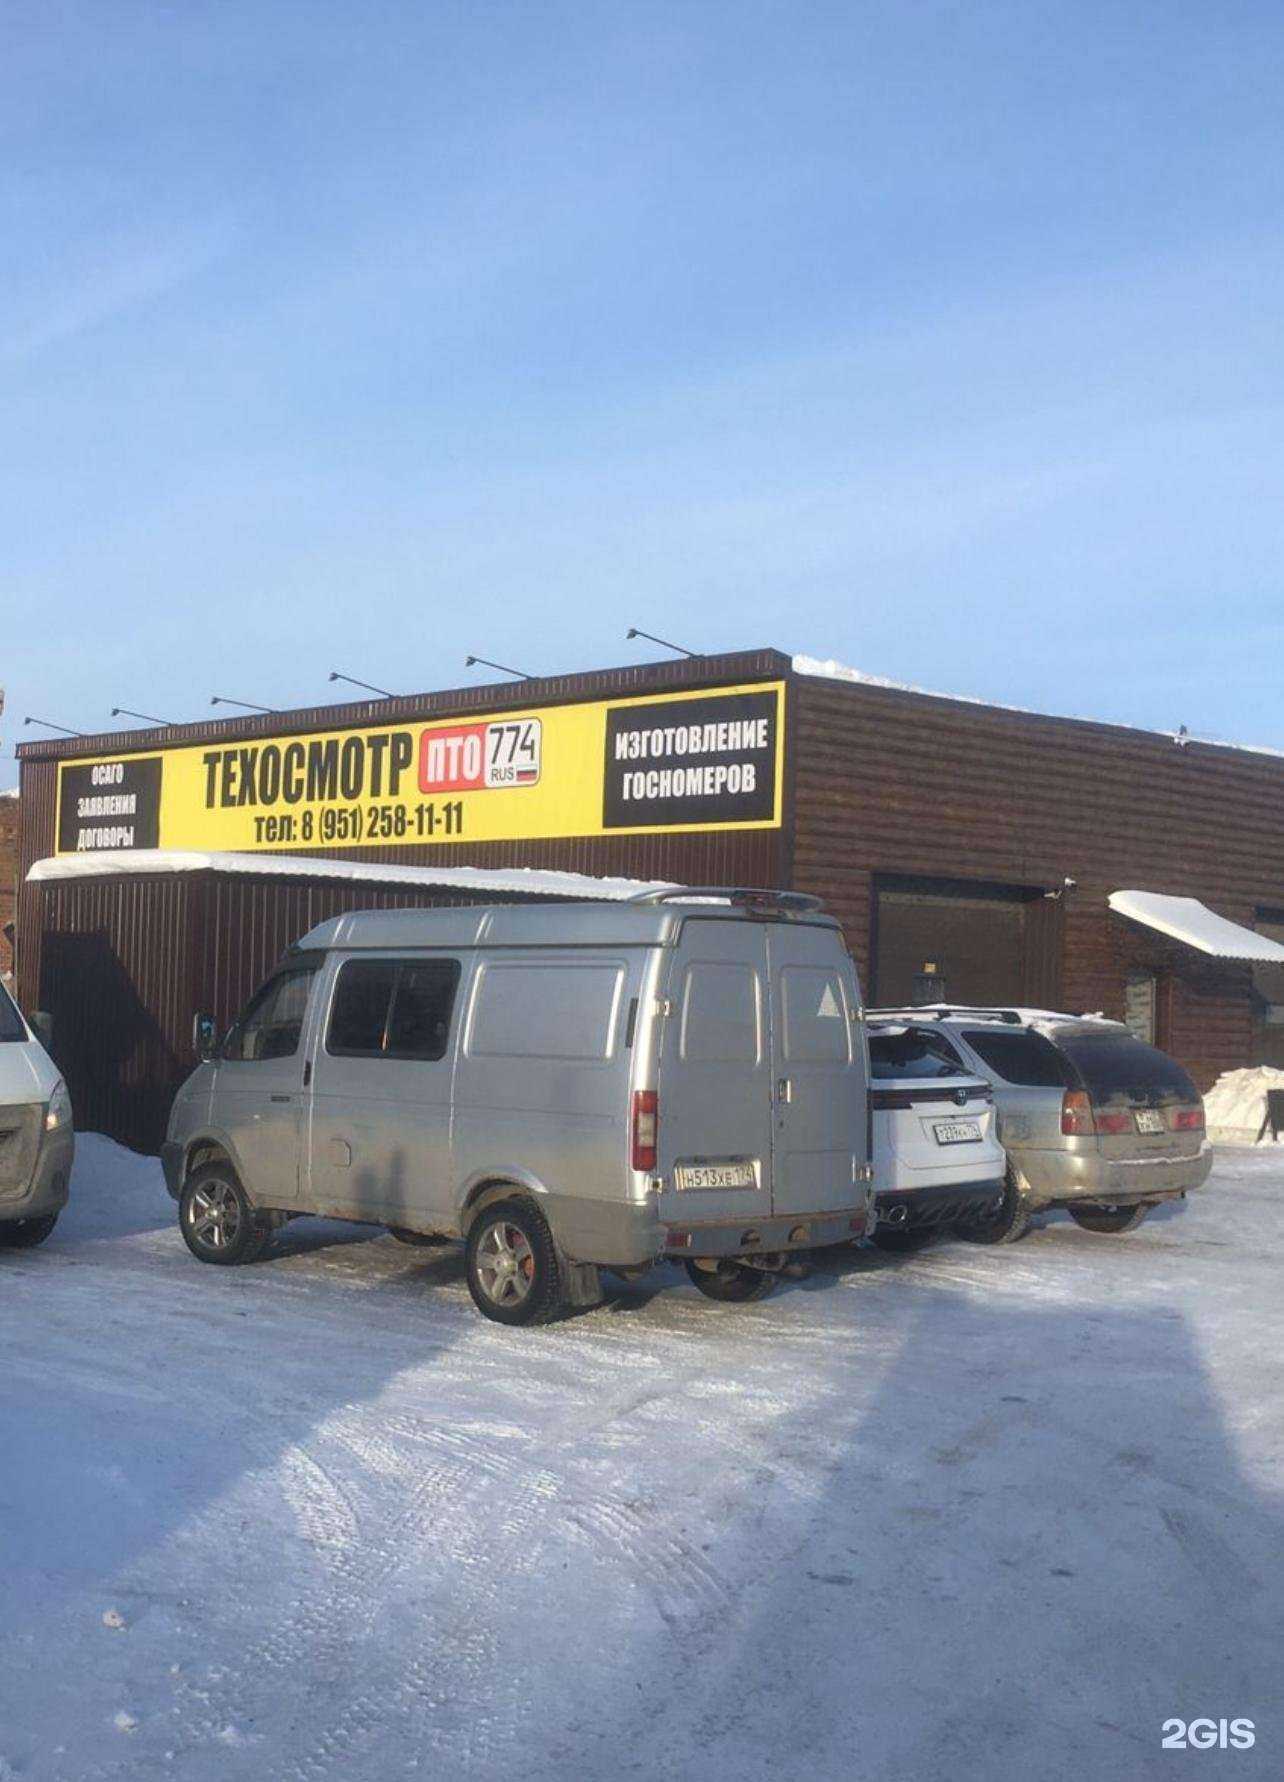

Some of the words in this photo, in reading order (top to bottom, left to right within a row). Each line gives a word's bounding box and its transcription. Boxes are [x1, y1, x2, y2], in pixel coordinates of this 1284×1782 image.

[615, 719, 769, 760] ИЗГОТОВЛЕНИЕ
[91, 763, 125, 785] ОСАГО
[203, 731, 413, 809] ТЕХОСМОТР
[427, 735, 481, 783] ПТО
[489, 723, 536, 765] 774
[490, 767, 514, 782] RUS
[622, 763, 757, 800] ГОСНОМЕРОВ
[77, 793, 137, 818] ЗАЯВЛЕНИЯ
[254, 813, 298, 844] тел:
[301, 810, 314, 841] 8
[319, 804, 364, 844] (951)
[367, 801, 464, 839] 258-11-11
[77, 826, 135, 852] ДОГОВОРЫ
